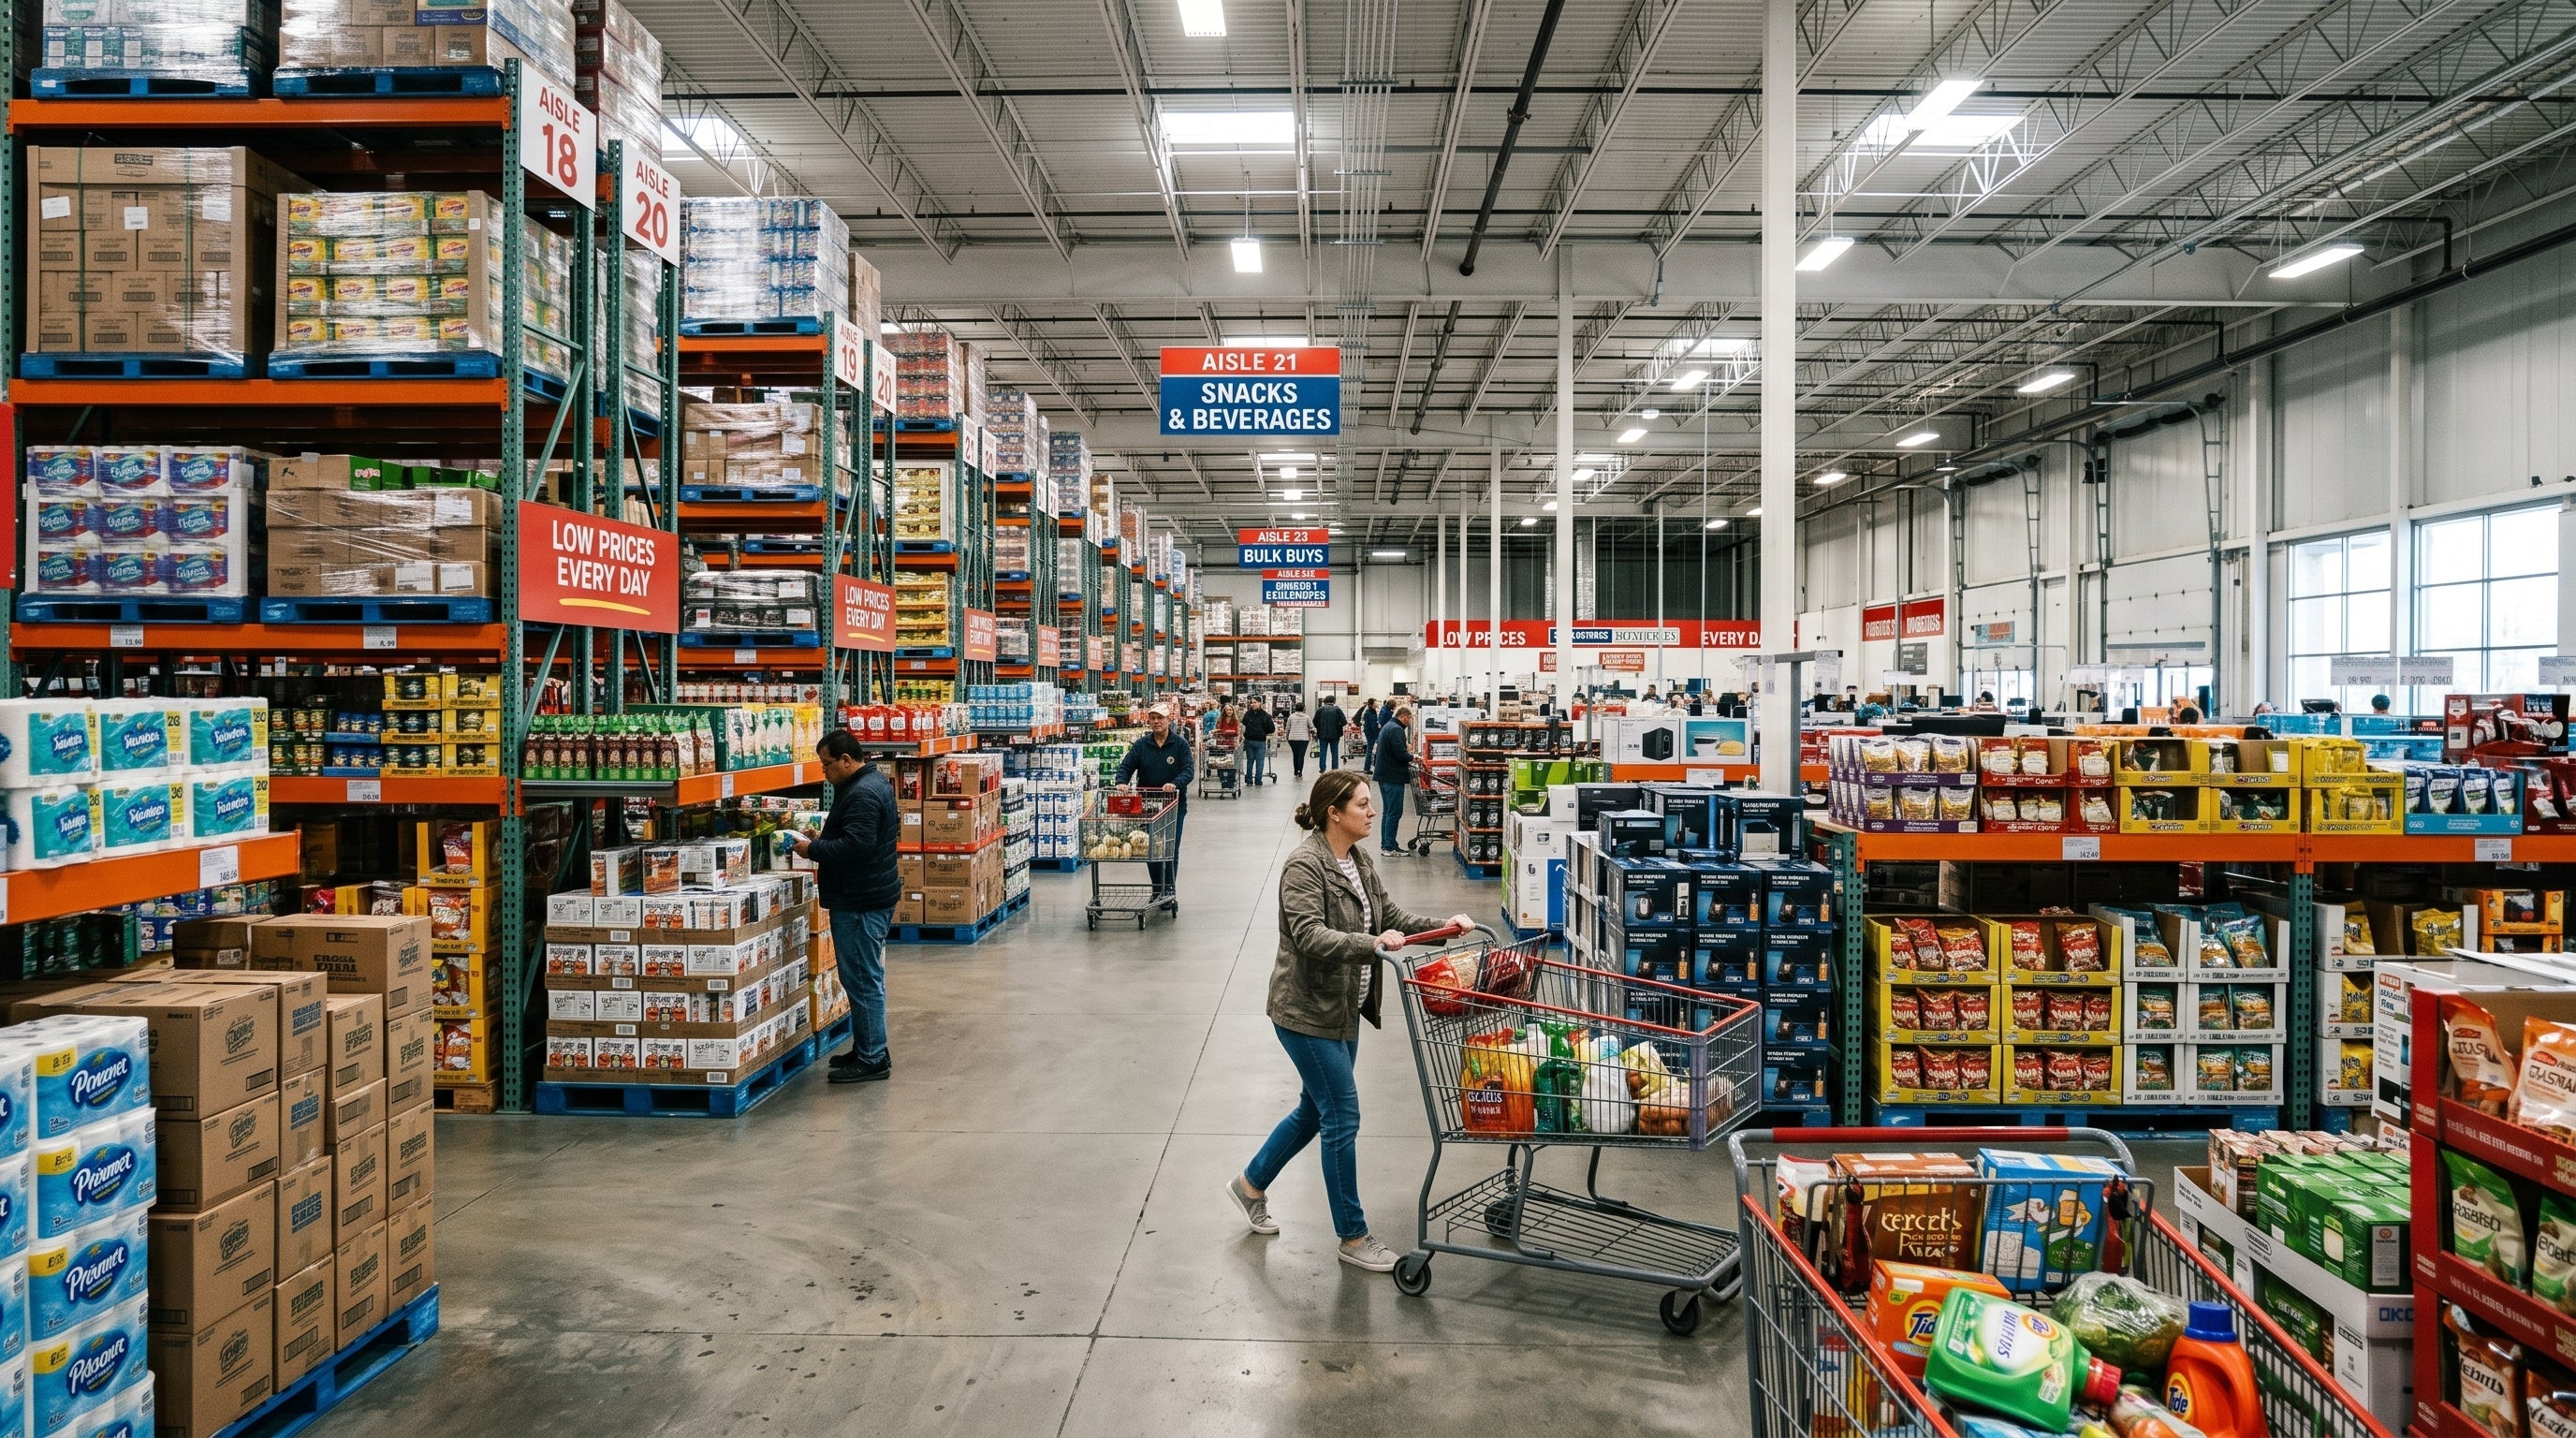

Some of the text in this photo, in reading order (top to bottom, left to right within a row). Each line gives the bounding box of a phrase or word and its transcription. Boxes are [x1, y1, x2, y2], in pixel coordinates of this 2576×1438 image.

[539, 86, 580, 134] AISLE
[542, 123, 578, 187] 18
[636, 160, 669, 199] AISLE
[636, 191, 668, 248] 20
[842, 345, 857, 382] 19
[1202, 353, 1296, 371] AISLE 21
[878, 370, 892, 405] 20
[1201, 382, 1297, 404] SNACKS
[1168, 408, 1331, 430] & BEVERAGES
[552, 520, 655, 566] LOW PRICES
[1258, 532, 1308, 542] AISLE 23
[1244, 550, 1324, 563] BULK BUYS
[558, 556, 651, 596] EVERY DAY
[845, 584, 862, 607] LOW
[846, 607, 886, 631] EVERY DAY
[1443, 631, 1526, 646] OW PRCES
[1703, 631, 1745, 645] EVERY
[1909, 1313, 1938, 1339] Tid
[2169, 1386, 2188, 1415] Tide
